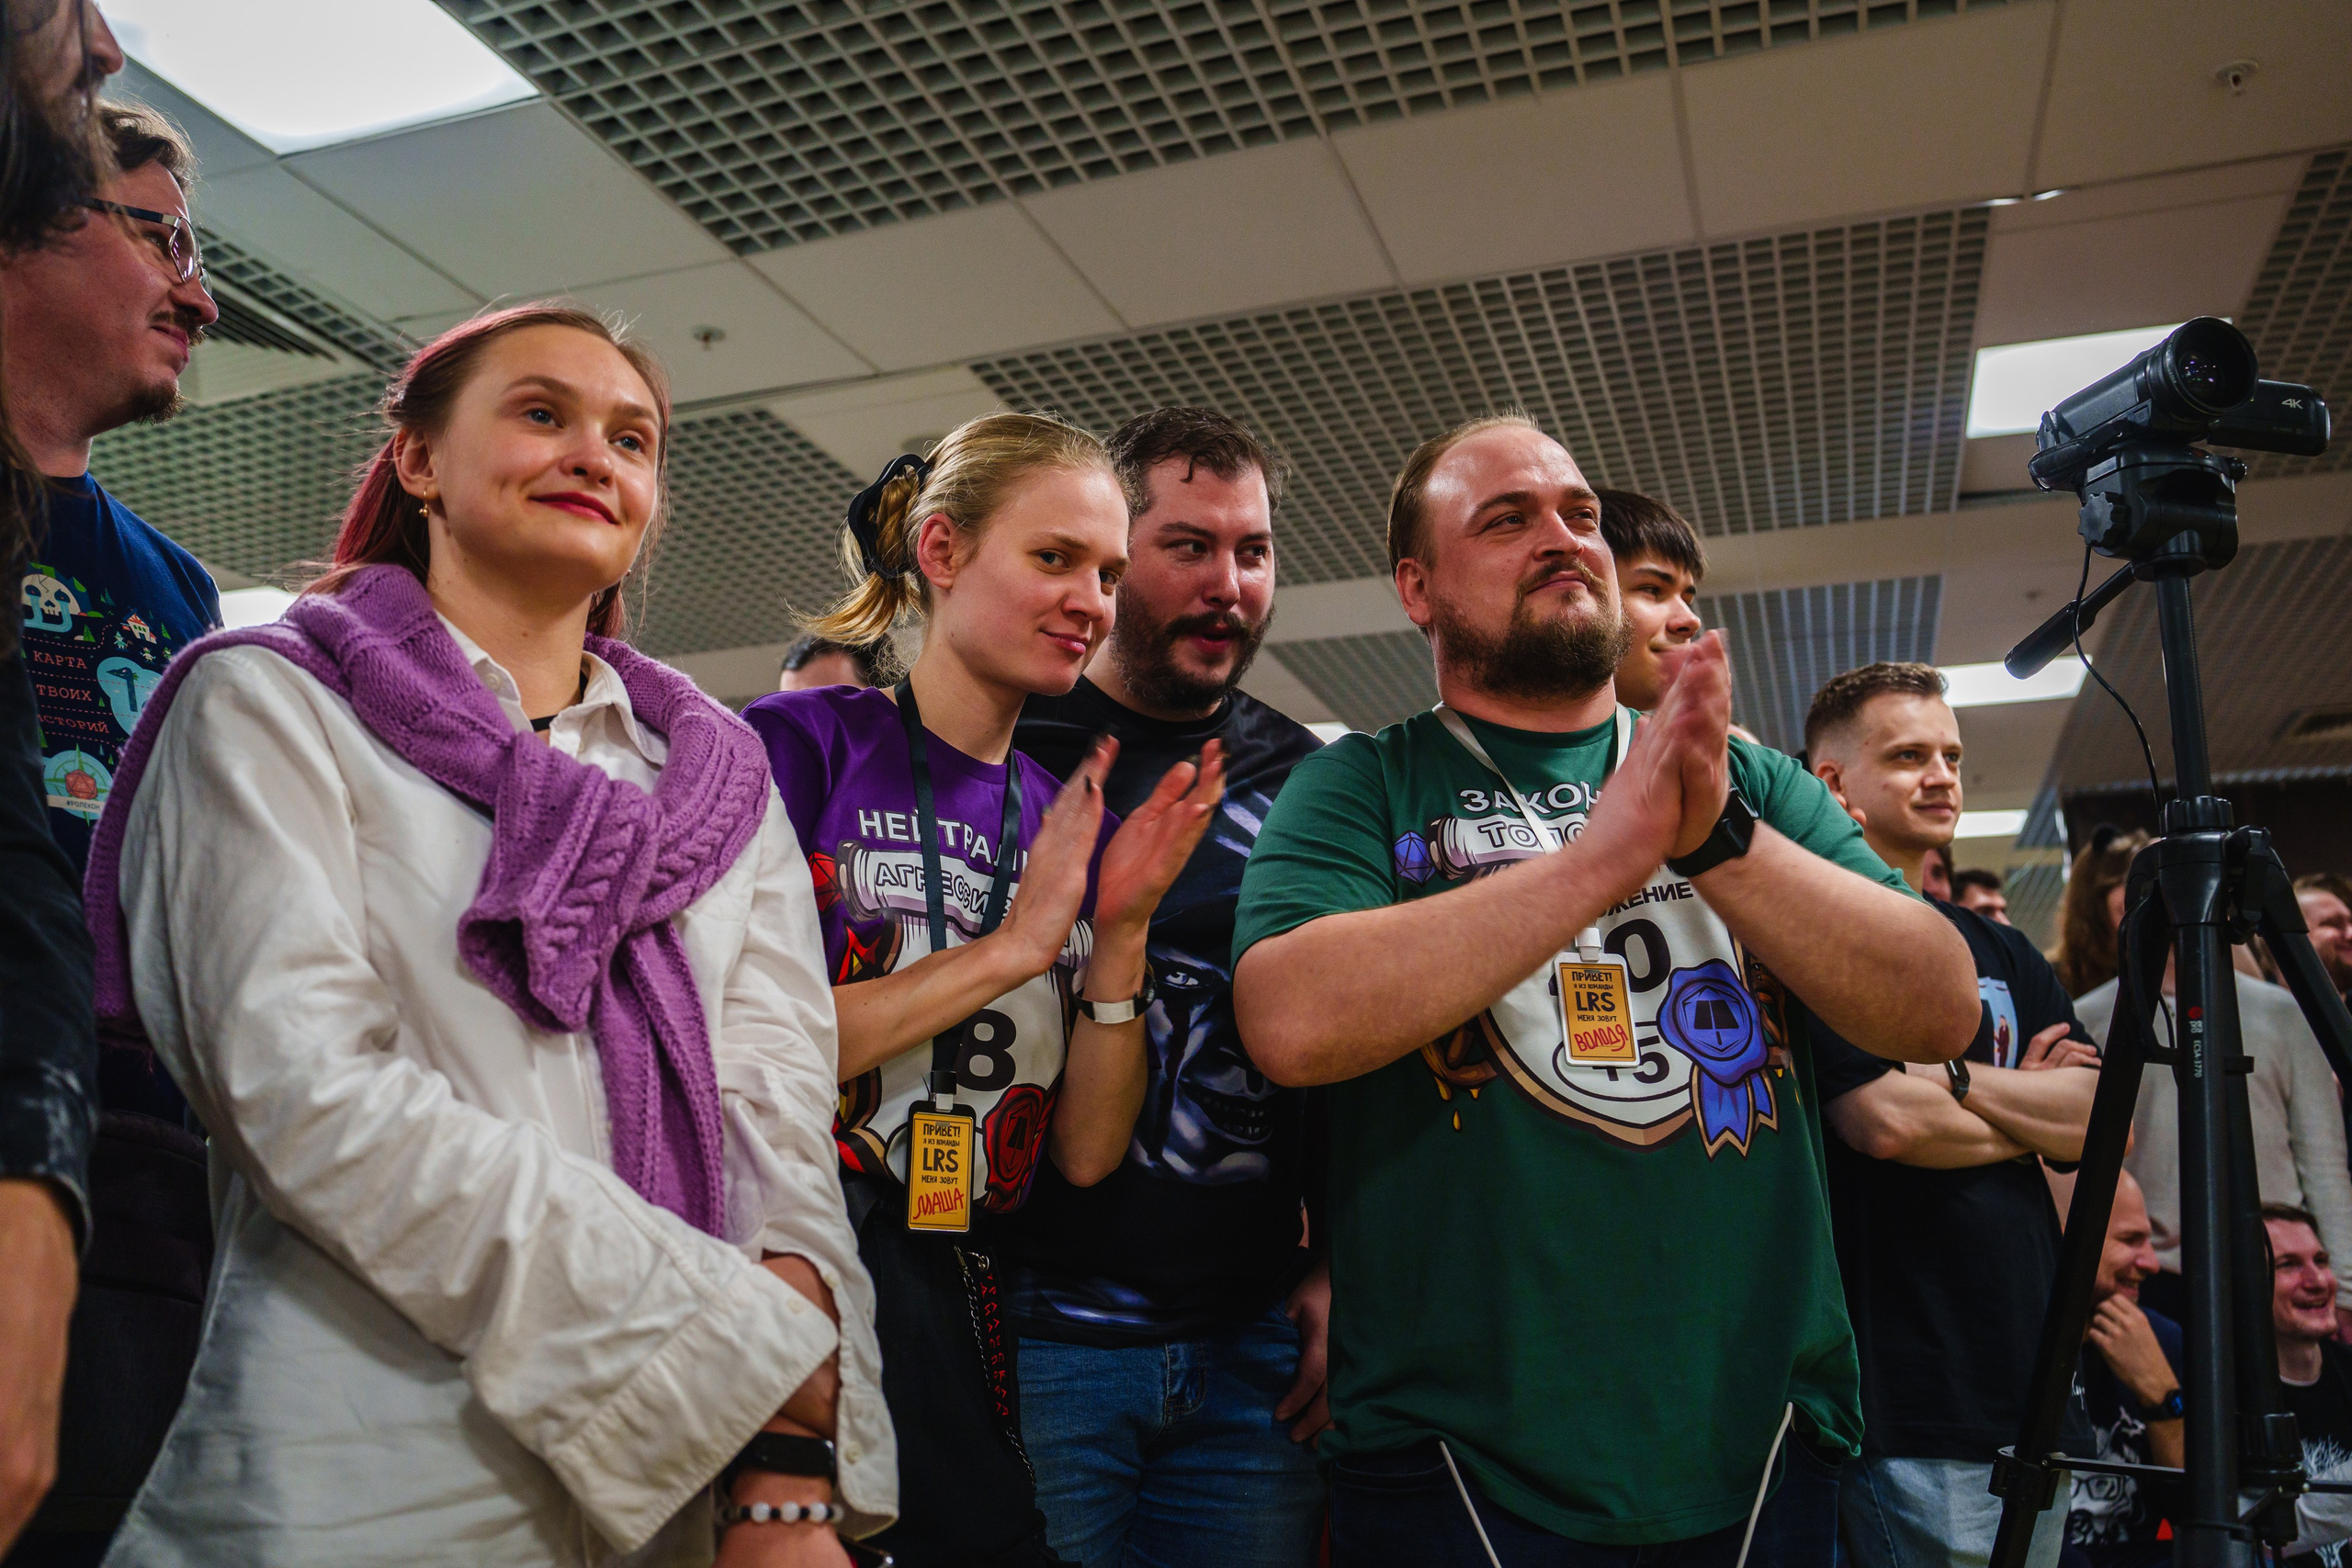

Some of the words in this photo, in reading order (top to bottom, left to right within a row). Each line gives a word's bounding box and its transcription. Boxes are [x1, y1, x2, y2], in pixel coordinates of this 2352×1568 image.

[2281, 398, 2303, 410] 4K
[33, 650, 87, 669] КАРТА
[36, 684, 92, 701] ТВОИХ
[1571, 971, 1612, 982] ПРИВЕТ!
[1575, 991, 1616, 1012] LRS
[1597, 1014, 1617, 1022] ЗОВУТ
[1574, 1023, 1629, 1052] ВОЛОДЯ
[922, 1123, 961, 1138] ПРИВЕТ!
[922, 1147, 959, 1173] LRS
[922, 1175, 937, 1184] МЕНЯ
[939, 1177, 958, 1185] ЗОВУТ
[912, 1188, 965, 1220] МАША
